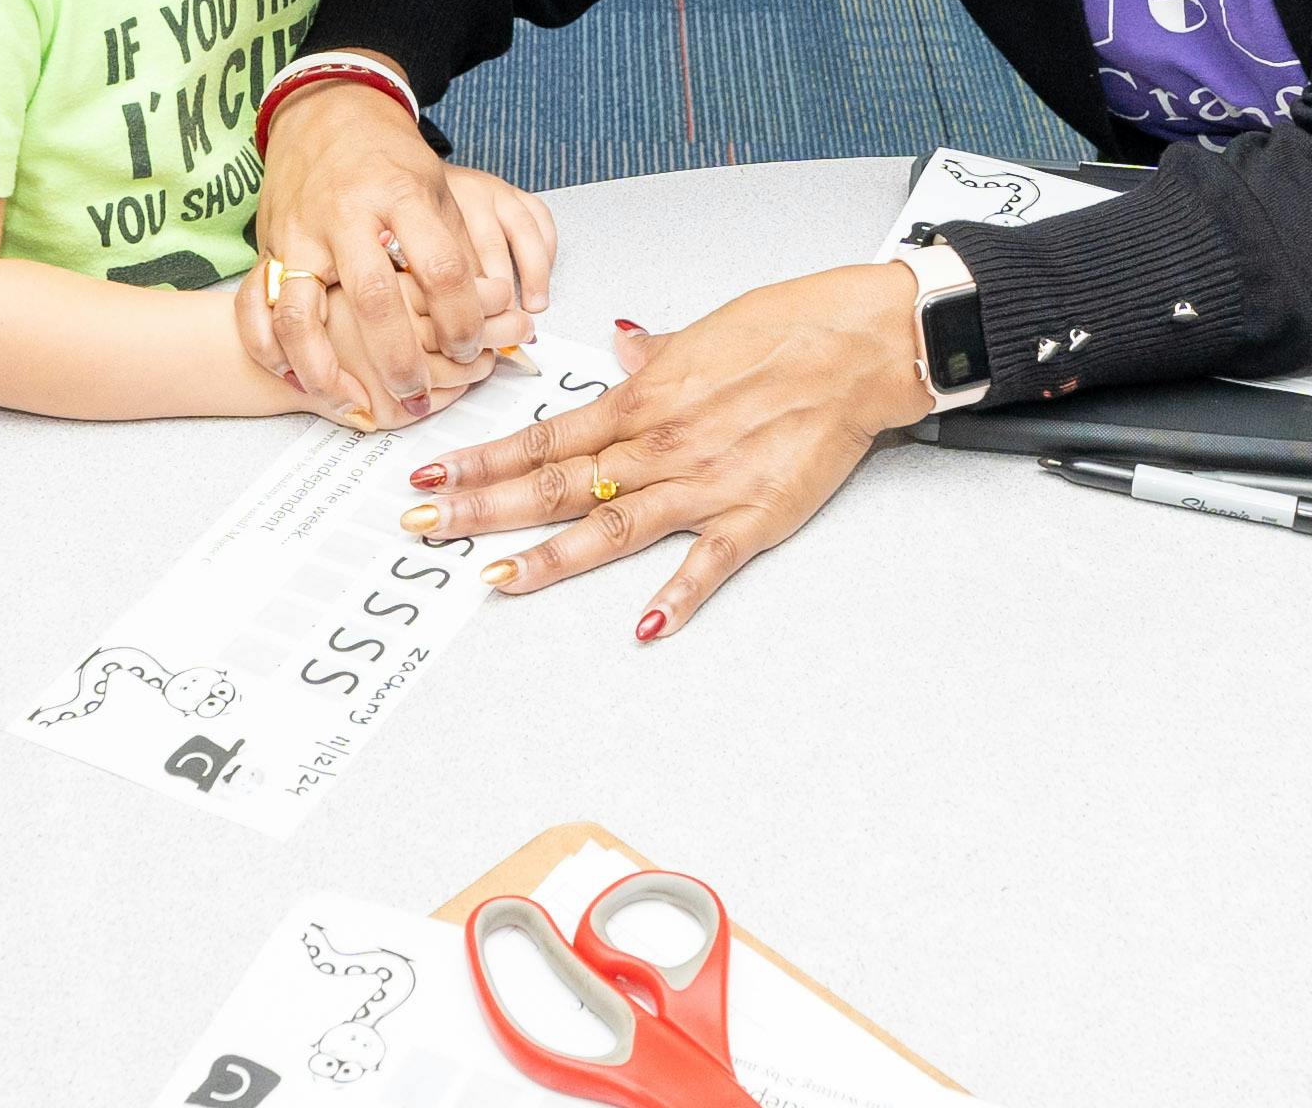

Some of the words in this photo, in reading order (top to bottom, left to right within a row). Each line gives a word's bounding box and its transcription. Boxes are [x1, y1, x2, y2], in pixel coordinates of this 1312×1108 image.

[104, 16, 140, 86] IF
[122, 74, 213, 181] I'M
[218, 0, 319, 130] CUT
[87, 189, 166, 248] YOU
[361, 431, 404, 468] Letter
[260, 429, 367, 532] emi-independent
[326, 482, 352, 505] the
[347, 467, 364, 484] of
[390, 555, 451, 590] S
[362, 590, 420, 627] S
[328, 625, 386, 663] S
[300, 657, 360, 696] S
